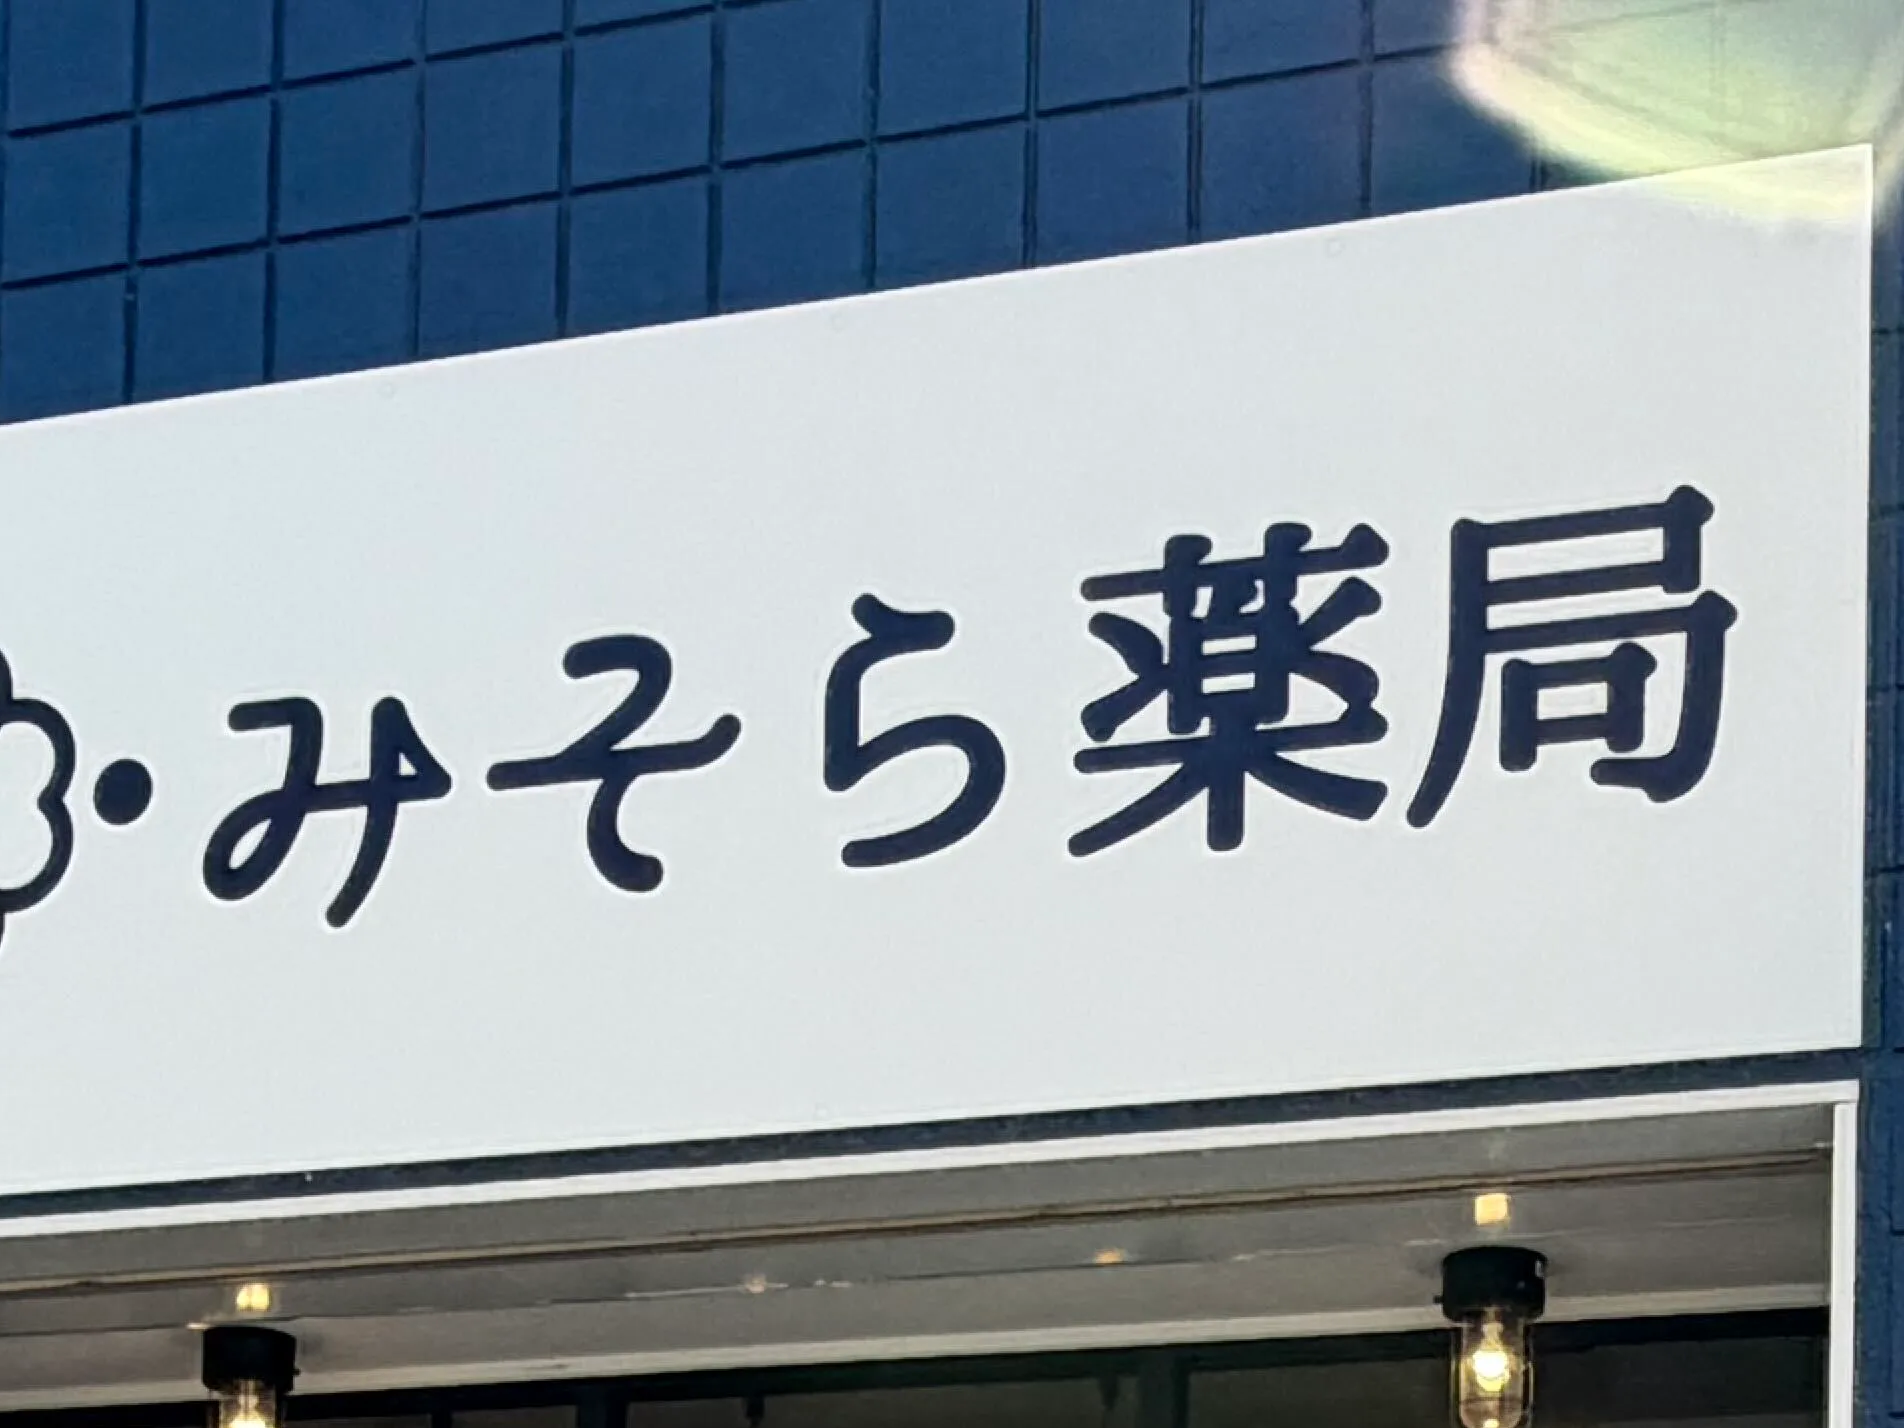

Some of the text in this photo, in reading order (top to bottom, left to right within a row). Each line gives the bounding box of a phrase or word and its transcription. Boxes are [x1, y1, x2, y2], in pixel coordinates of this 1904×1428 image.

[201, 484, 1736, 929] みそら薬局
